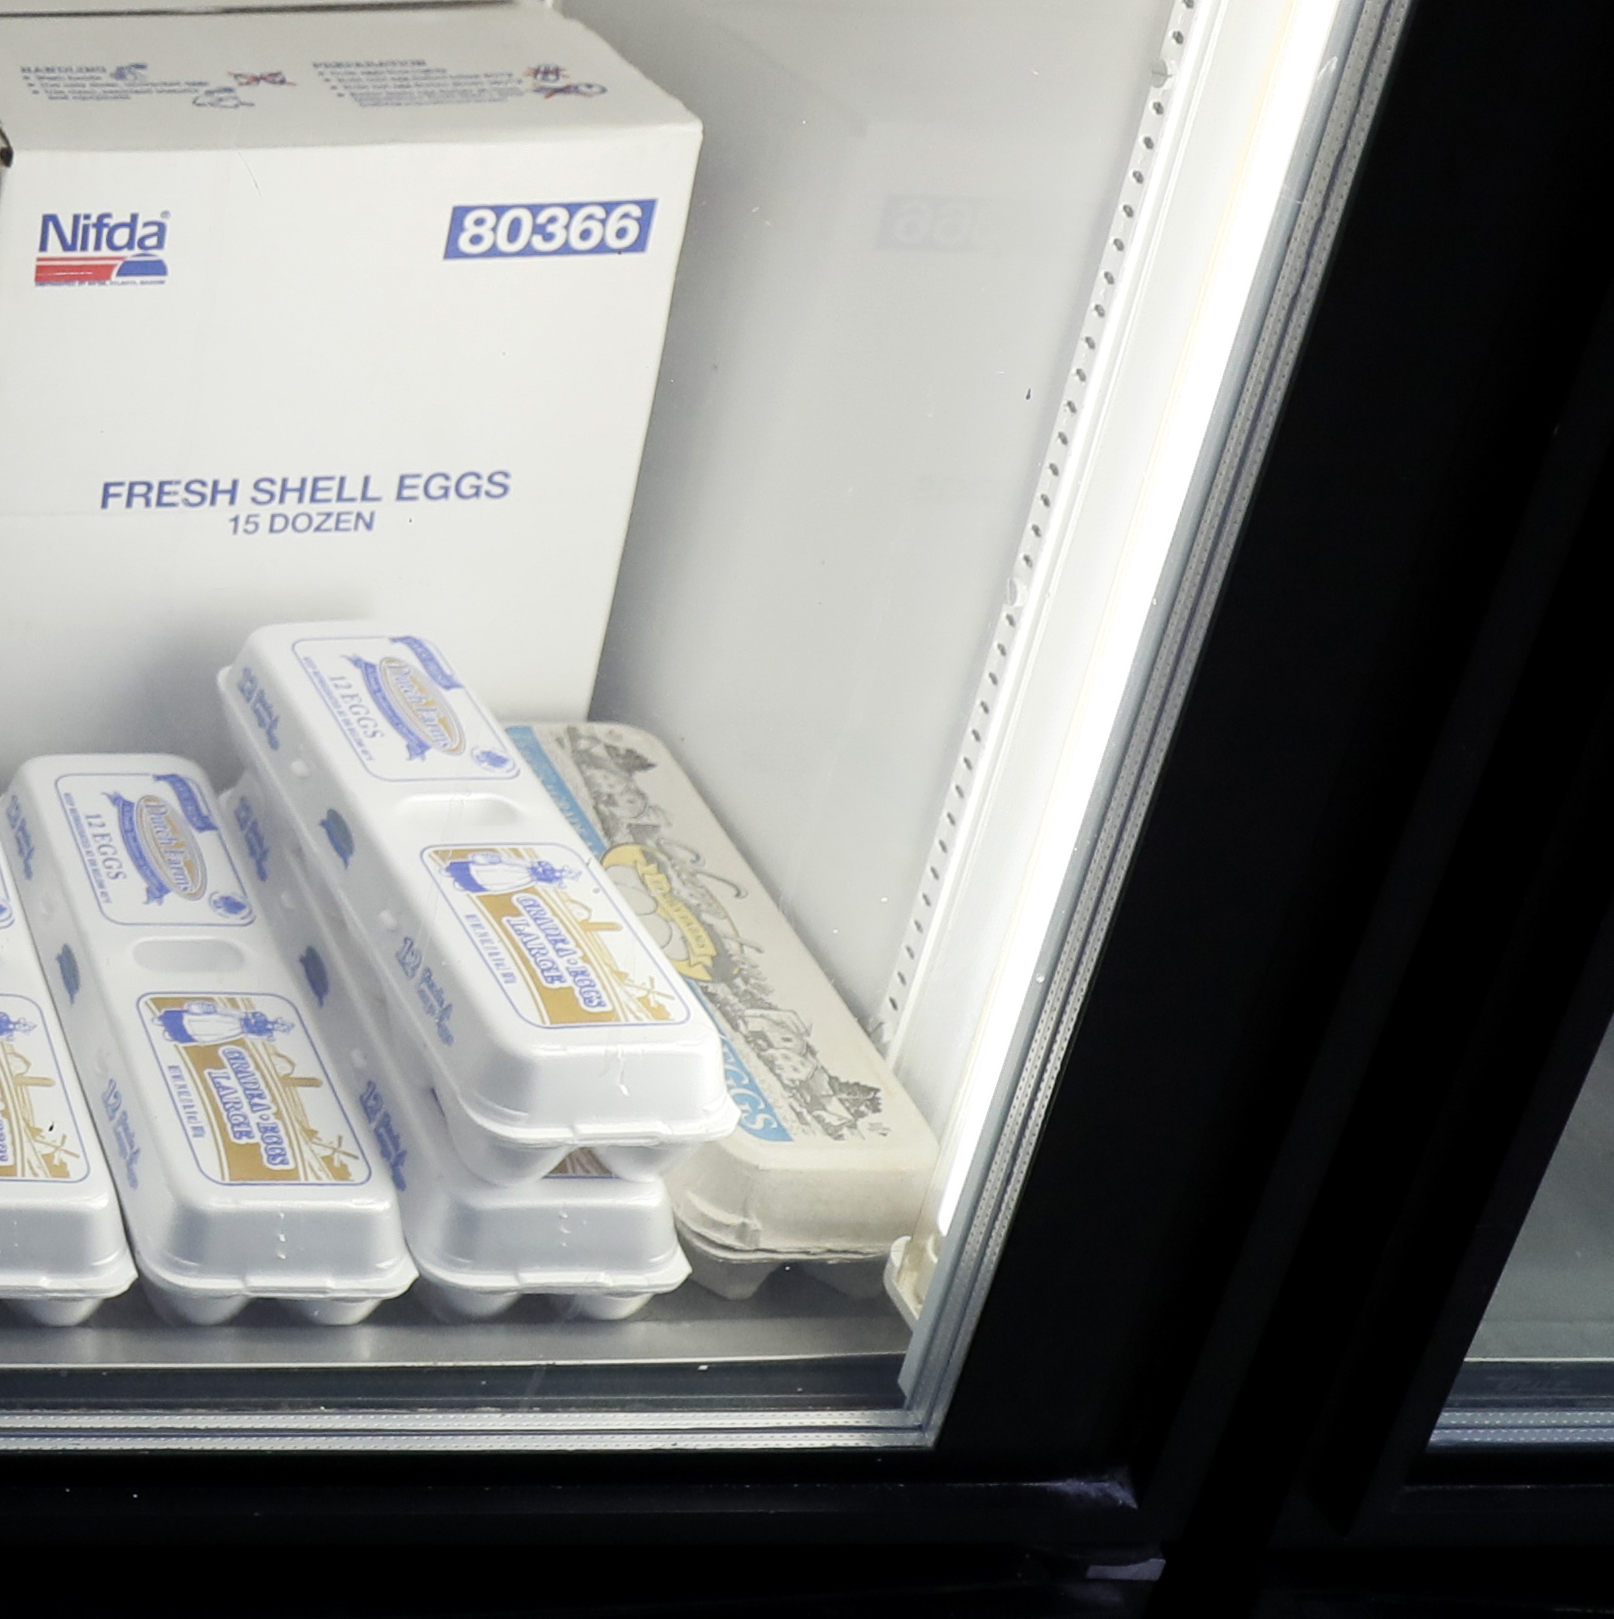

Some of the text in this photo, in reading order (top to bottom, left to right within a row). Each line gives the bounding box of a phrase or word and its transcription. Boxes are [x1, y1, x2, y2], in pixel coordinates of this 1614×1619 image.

[38, 212, 168, 252] Nifda
[456, 204, 645, 255] 80366
[101, 470, 512, 510] FRESH SHELL EGGS
[228, 510, 376, 535] 15 DOZEN
[328, 674, 385, 740] 12 EGGS
[84, 813, 128, 882] 12 EGGS
[144, 802, 193, 894] Dutch Farms
[506, 917, 567, 986] LARGE
[207, 1071, 256, 1142] LARGE
